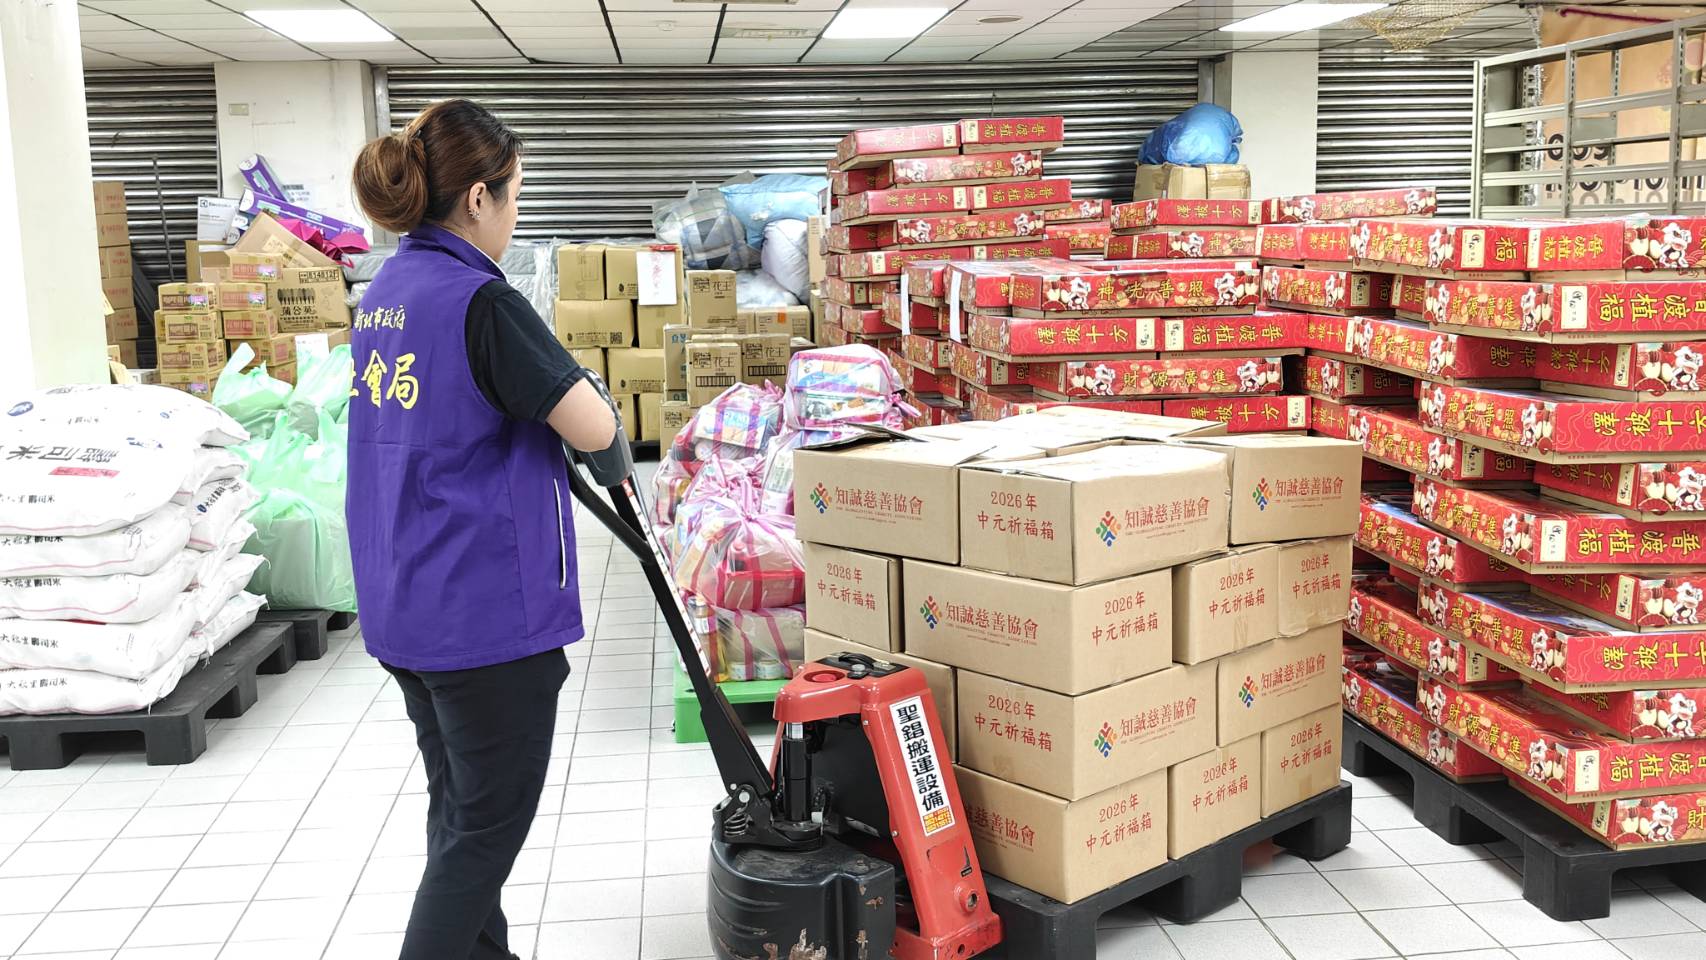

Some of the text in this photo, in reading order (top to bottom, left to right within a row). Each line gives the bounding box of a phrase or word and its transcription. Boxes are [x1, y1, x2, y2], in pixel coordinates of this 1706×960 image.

[1176, 203, 1243, 219] 澤被十方
[1544, 232, 1604, 262] 普渡植福
[1097, 279, 1205, 301] 神光普照
[354, 304, 406, 332] 新北市政府
[1452, 294, 1515, 322] 財源廣進
[1036, 323, 1129, 345] 澤被十方
[1192, 324, 1285, 346] 普渡植福
[1122, 368, 1228, 389] 財源廣進
[1448, 391, 1514, 430] 神光普照
[836, 486, 923, 515] 知誠慈善協會
[990, 490, 1038, 509] 2026年
[1275, 476, 1344, 496] 知誠慈善協會
[977, 510, 1055, 541] 中元祈福箱
[1125, 496, 1209, 528] 知誠慈善協會
[1439, 497, 1497, 541] 財源廣進
[1363, 518, 1422, 555] 神光普照
[1578, 528, 1702, 557] 普渡植福
[827, 562, 863, 584] 2026年
[1300, 553, 1330, 573] 2026年
[1219, 567, 1255, 590] 2026年
[1292, 573, 1342, 597] 中元祈福箱
[817, 580, 876, 612] 中元祈福箱
[1104, 590, 1146, 616] 2026年
[1208, 587, 1266, 619] 中元祈福箱
[946, 601, 1038, 640] 知誠慈善協會
[1091, 612, 1159, 647] 中元祈福箱
[1364, 612, 1423, 659] 財源廣進
[1451, 605, 1524, 652] 神光普照
[1261, 653, 1326, 689] 知誠慈善協會
[988, 694, 1037, 719] 2026年
[1120, 696, 1197, 737] 知誠慈善協會
[1362, 694, 1423, 744] 神光普照
[974, 712, 1053, 752] 中元祈福箱
[1290, 721, 1323, 747] 2026年
[1449, 703, 1521, 761] 財源廣進
[896, 703, 945, 812] 聖錩搬運設備
[1203, 757, 1238, 783] 2026年
[1280, 739, 1333, 773] 中元祈福箱
[1098, 793, 1140, 823] 2026年
[1191, 774, 1250, 813] 中元祈福箱
[1085, 812, 1153, 852] 中元祈福箱
